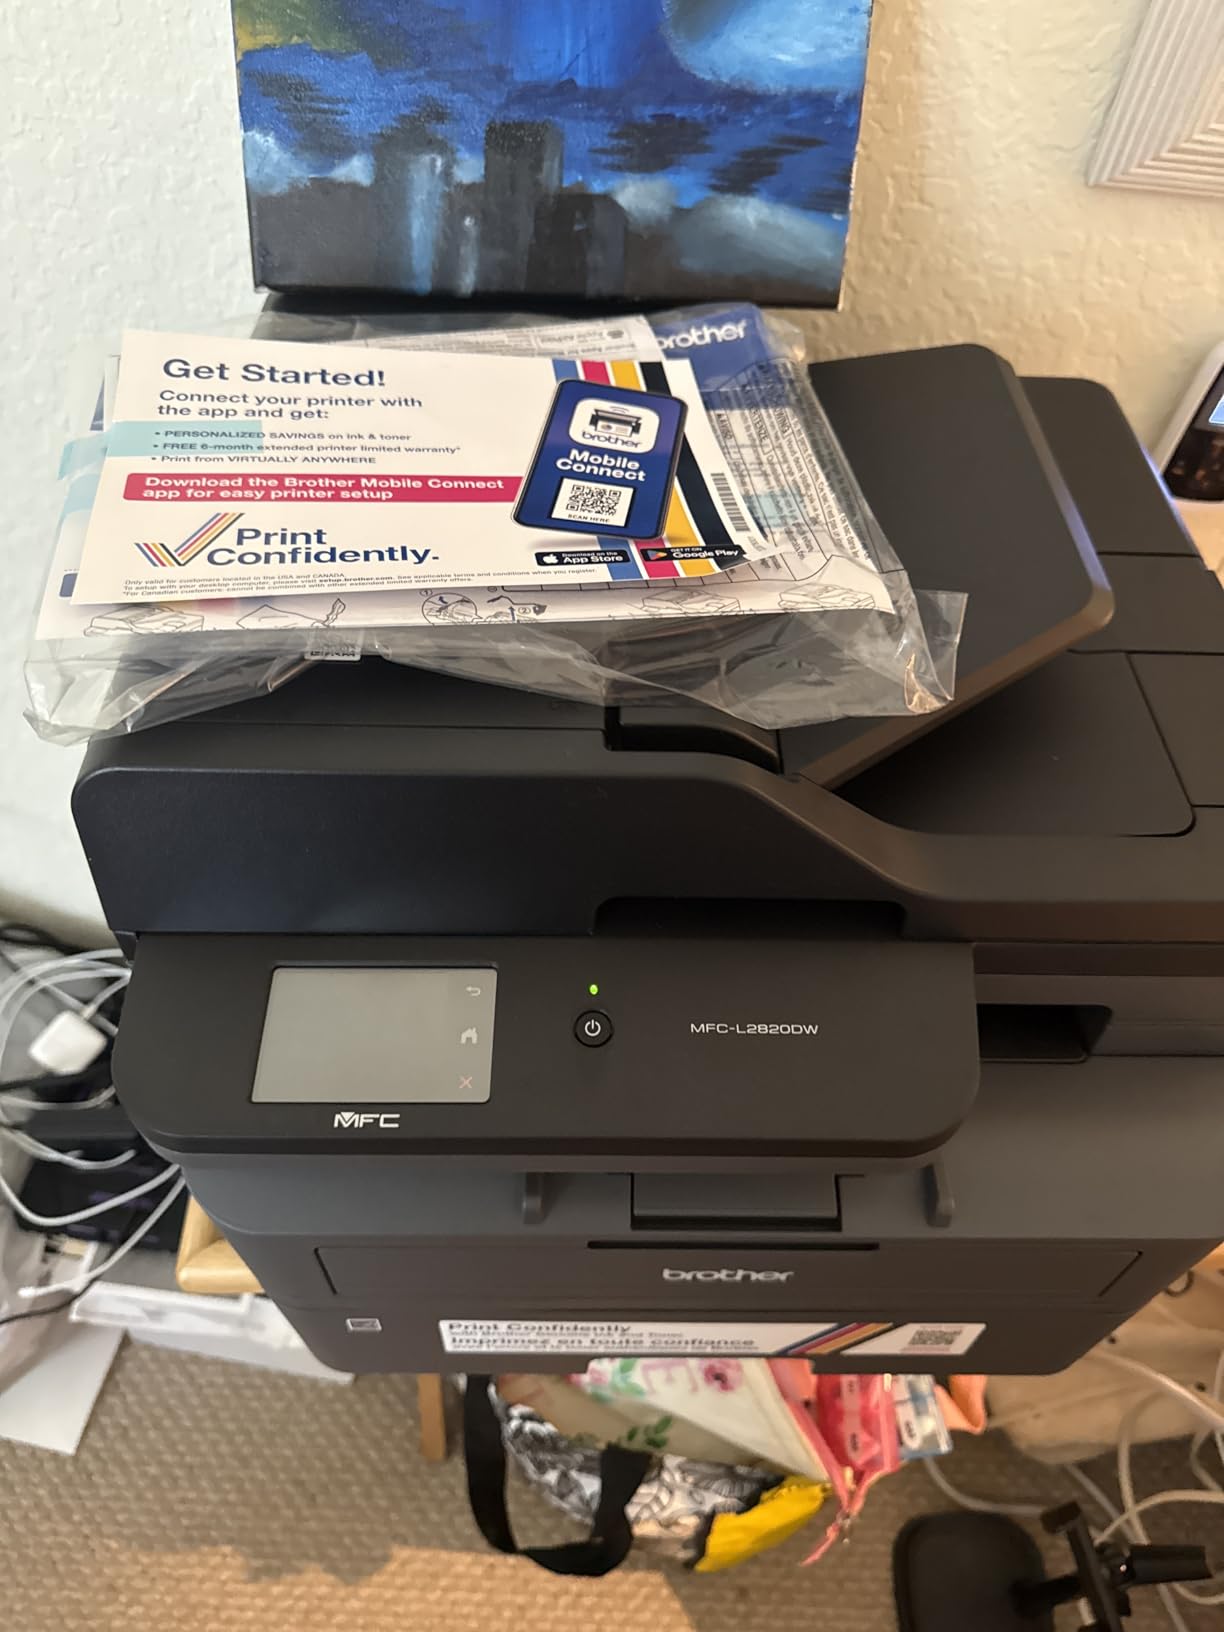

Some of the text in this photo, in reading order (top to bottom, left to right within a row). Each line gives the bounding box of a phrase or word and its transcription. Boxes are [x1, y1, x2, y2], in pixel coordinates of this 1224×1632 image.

[163, 358, 385, 387] Get Started!
[159, 389, 423, 407] Connect your printer with
[158, 405, 329, 421] the app and get:
[164, 430, 265, 439] PERSONALIZED
[269, 432, 325, 440] SAVINGS
[582, 430, 641, 448] brother
[201, 443, 253, 451] 6-month
[257, 444, 314, 452] extended
[317, 445, 357, 453] printer
[361, 445, 401, 453] limited
[161, 455, 191, 463] Print
[195, 455, 224, 463] from
[301, 456, 376, 464] ANYWHERE
[569, 448, 640, 470] Mobile
[556, 458, 646, 481] Connect
[145, 477, 504, 489] Download the Brother Mobile Connect
[143, 489, 393, 500] app for easy printer setup
[236, 528, 327, 546] Print
[207, 546, 439, 566] Confidently.
[563, 554, 623, 565] App Store
[672, 547, 739, 560] Google Play
[690, 1023, 819, 1035] MFC-L2820DW
[333, 1112, 400, 1128] MFC
[662, 1268, 795, 1282] brother
[507, 1323, 631, 1332] Confidently
